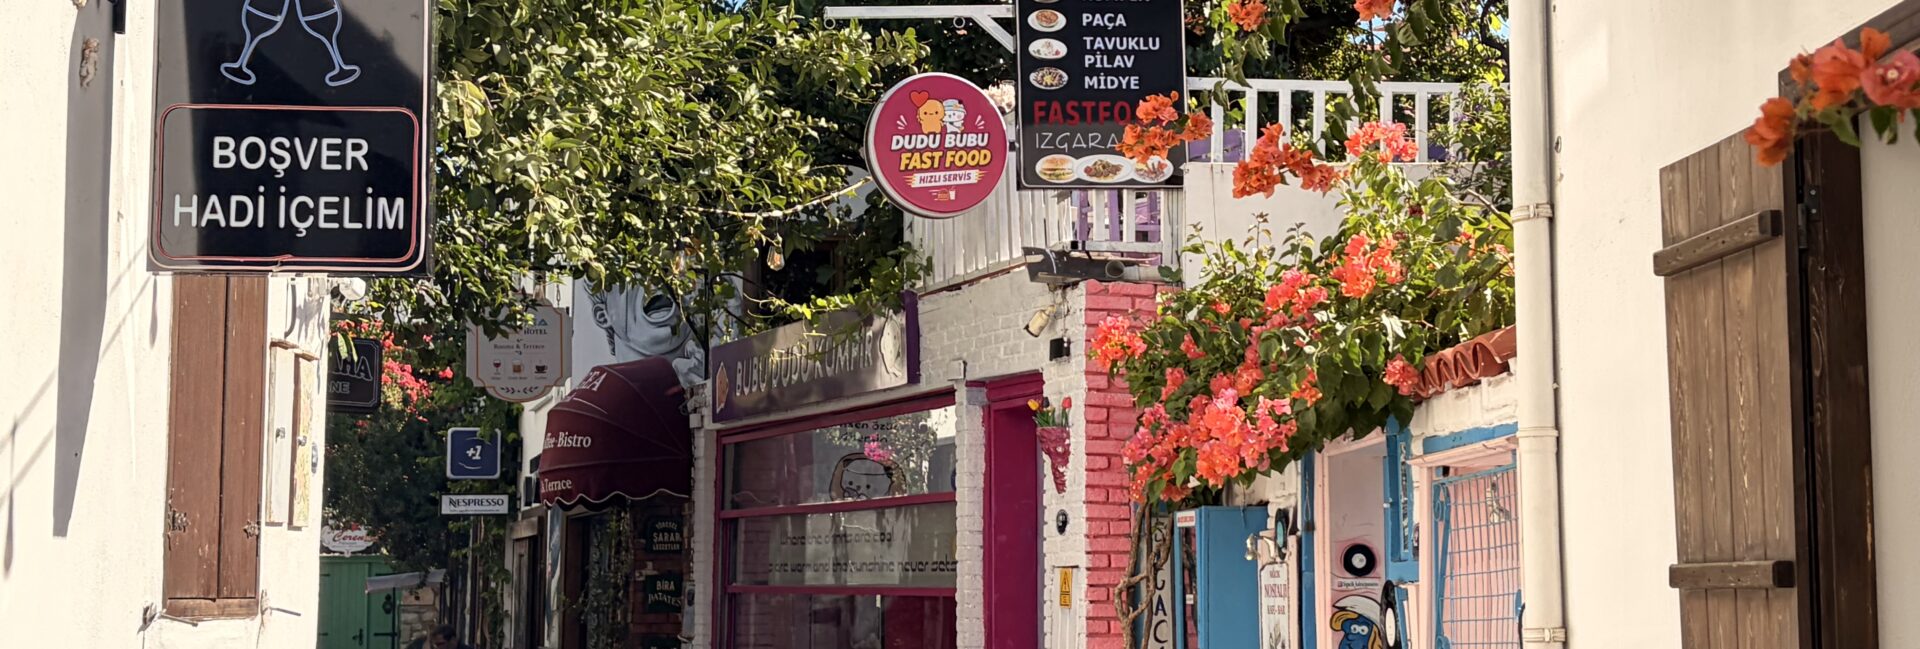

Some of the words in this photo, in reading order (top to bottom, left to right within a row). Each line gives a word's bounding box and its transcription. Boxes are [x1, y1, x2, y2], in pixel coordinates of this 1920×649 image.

[1082, 13, 1126, 30] PAÇA
[1083, 37, 1160, 50] TAVUKLU
[1084, 52, 1134, 68] PİLAV
[1084, 73, 1140, 90] MİDYE
[1033, 100, 1150, 126] FASTFO
[891, 134, 940, 150] DUDU
[944, 133, 988, 148] BUBU
[212, 136, 369, 178] BOŞVER
[900, 151, 942, 171] FAST
[945, 149, 991, 168] FOOD
[919, 174, 940, 184] HIZLI
[943, 171, 971, 183] SERVİS
[173, 185, 265, 229] HADİ
[278, 185, 405, 237] İÇELİM
[735, 354, 768, 397] BUBU
[449, 497, 504, 508] NESPRESSO
